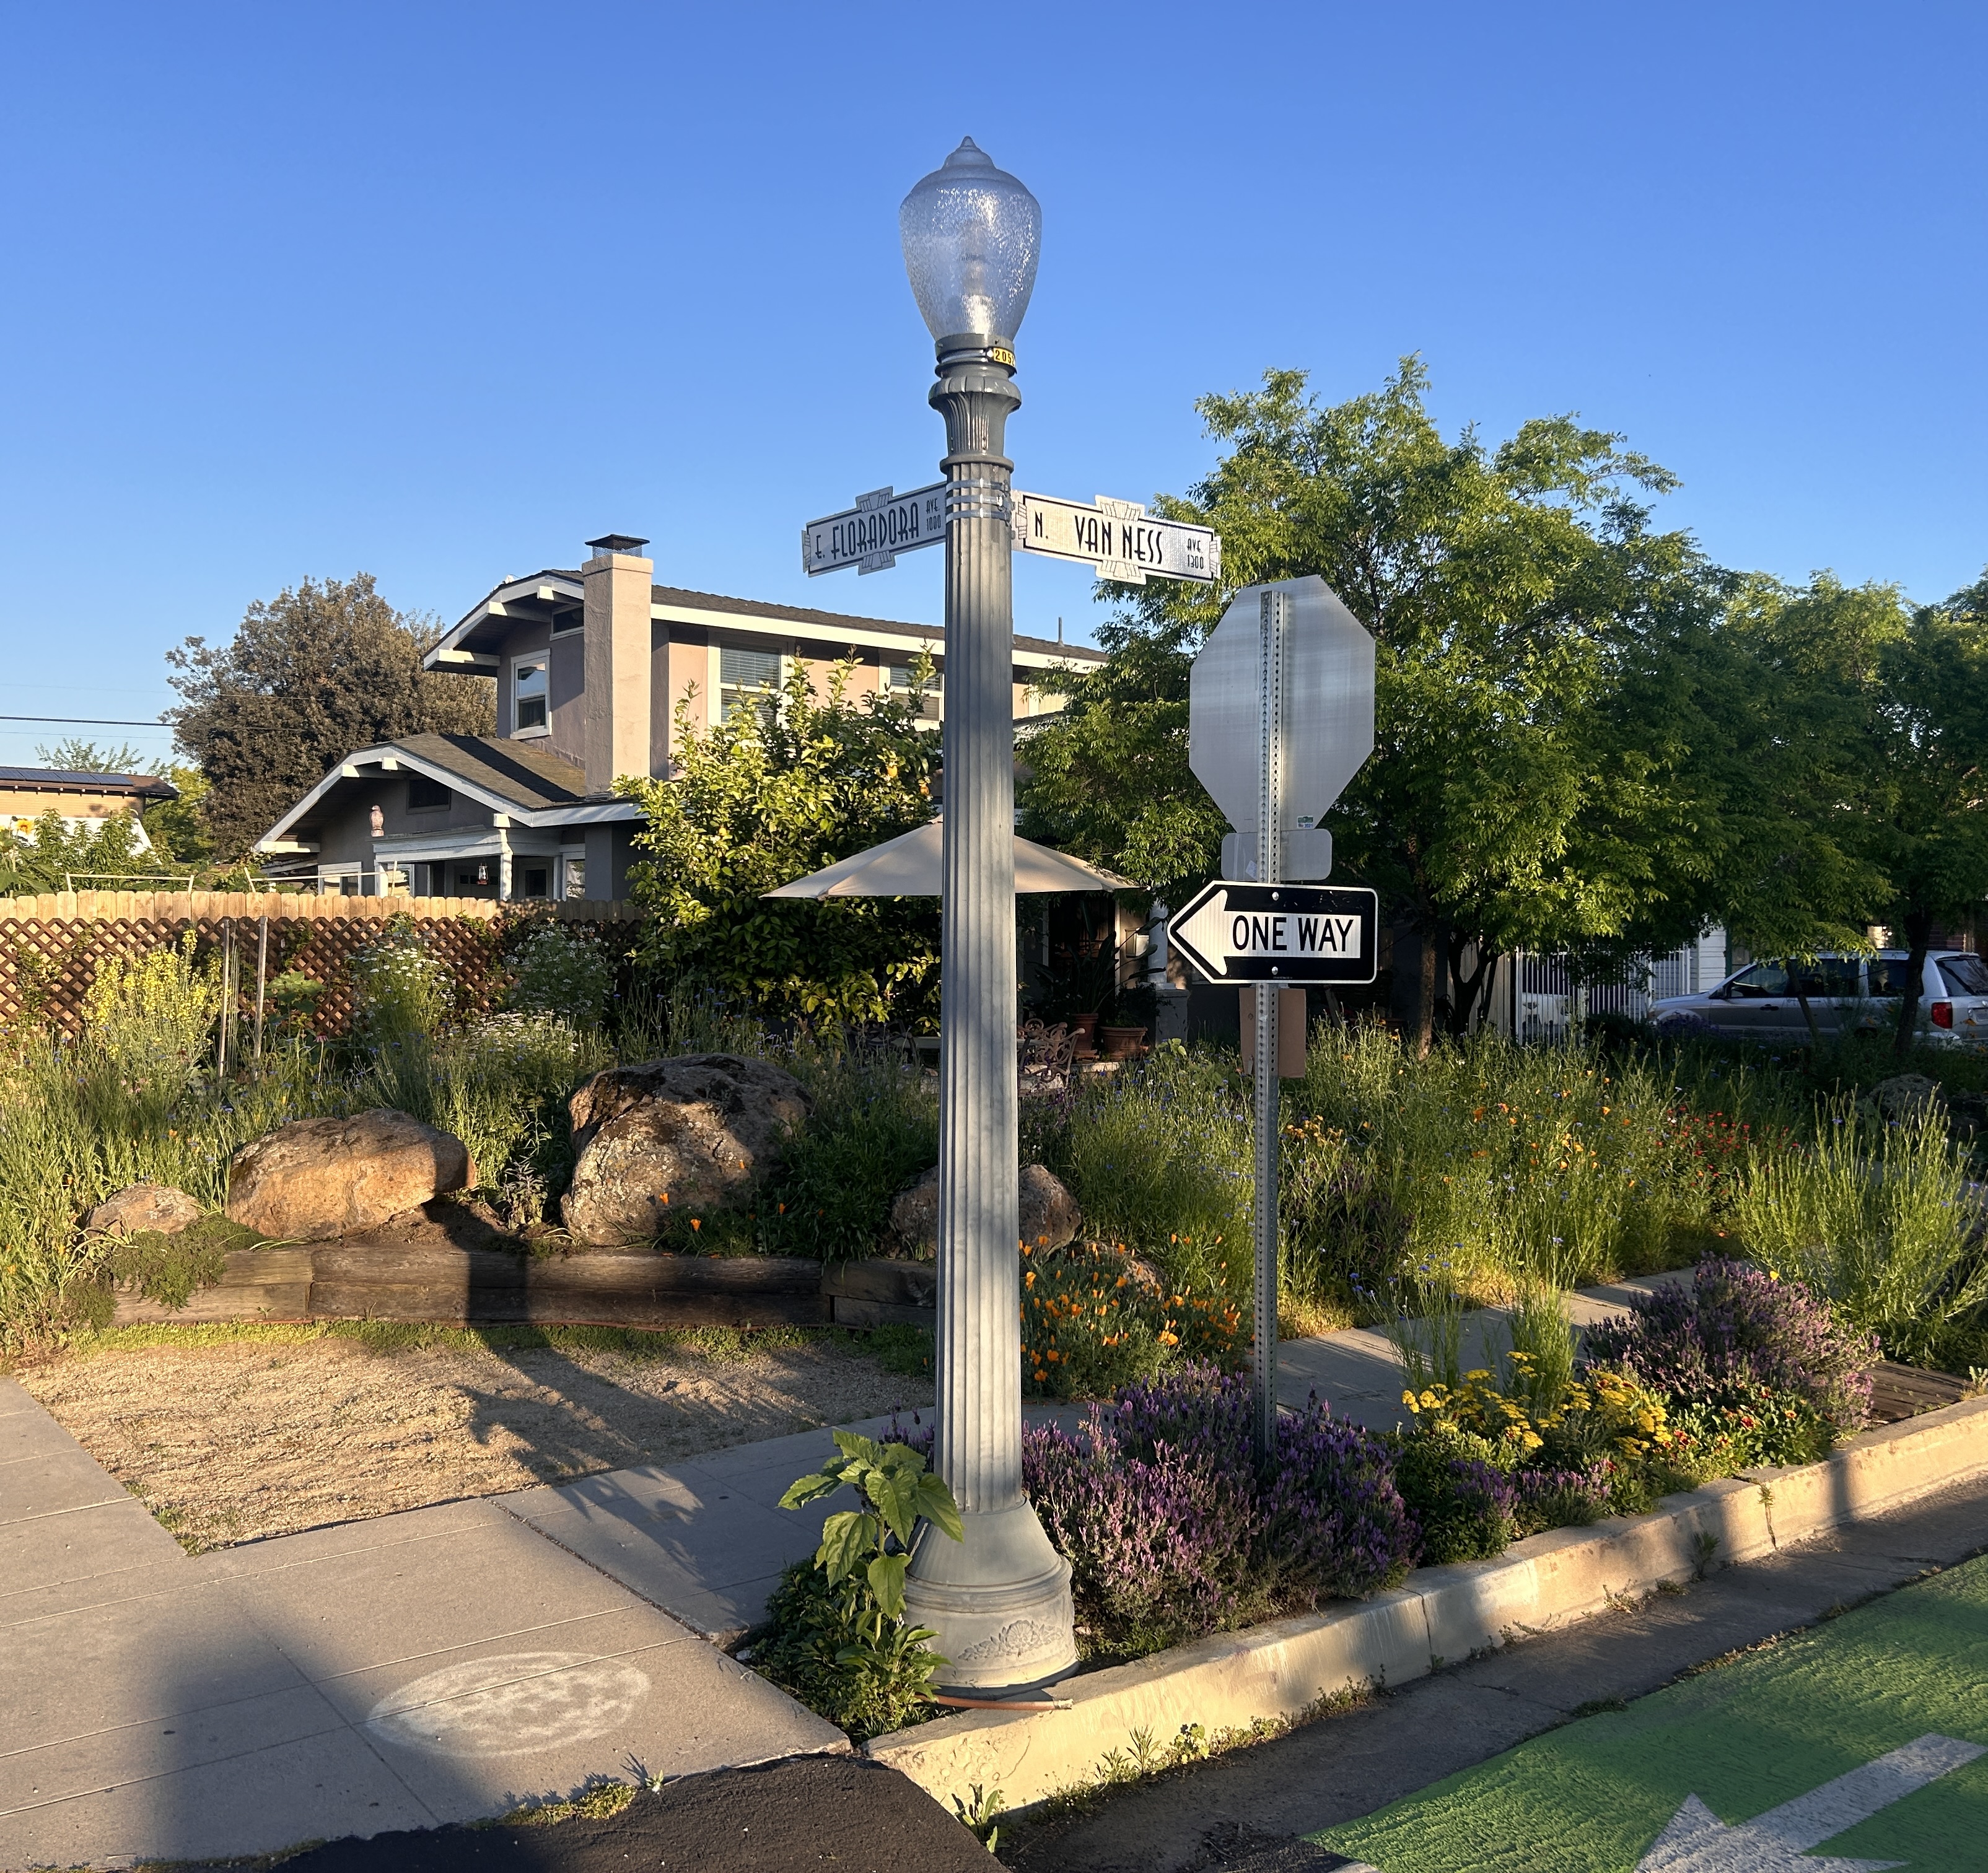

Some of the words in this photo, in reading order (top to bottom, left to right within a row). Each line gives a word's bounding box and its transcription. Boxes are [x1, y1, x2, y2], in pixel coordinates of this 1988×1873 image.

[815, 535, 825, 559] E.
[831, 502, 919, 560] FLORADORA
[926, 514, 941, 531] 1000
[1034, 511, 1049, 539] N.
[1074, 515, 1112, 556] VAN
[1122, 523, 1163, 565] NESS
[1187, 554, 1204, 570] 1300
[1232, 914, 1287, 951] ONE
[1298, 917, 1354, 952] WAY
